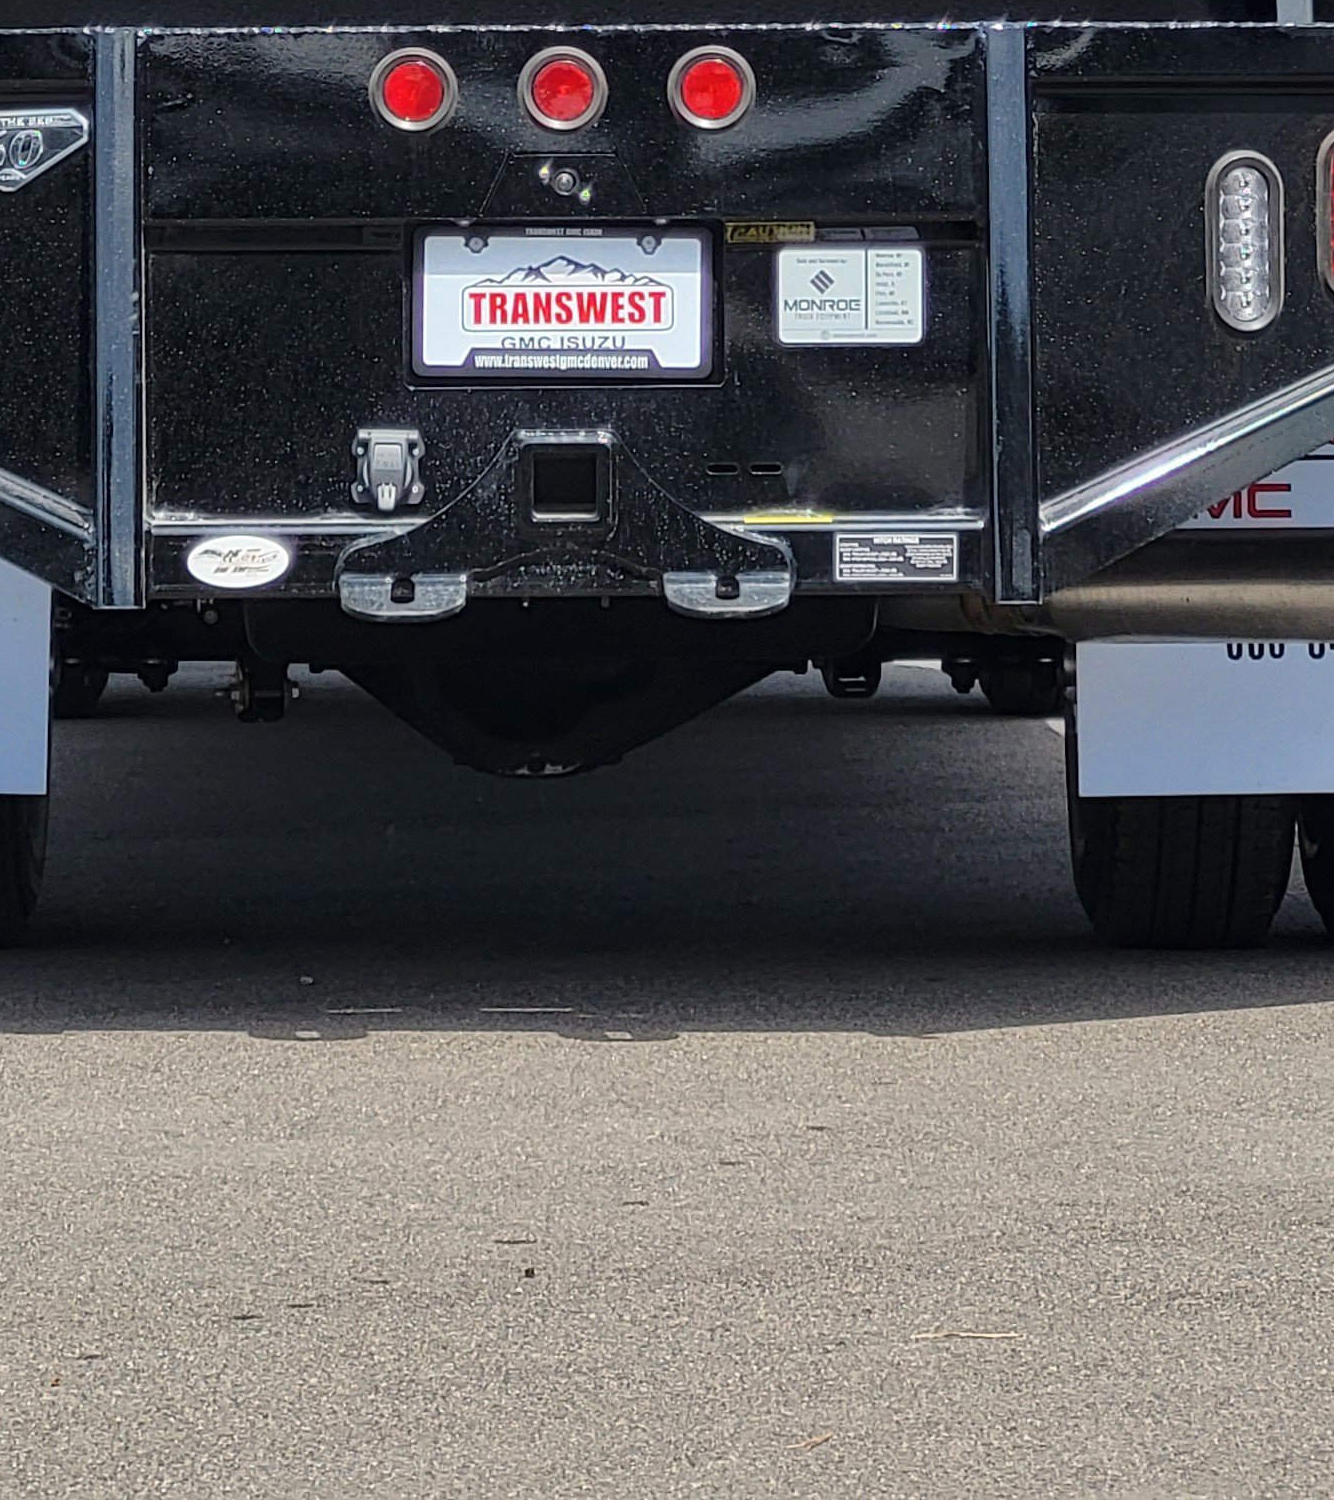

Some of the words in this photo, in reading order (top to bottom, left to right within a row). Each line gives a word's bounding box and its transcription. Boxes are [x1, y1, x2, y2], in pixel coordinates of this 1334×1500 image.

[1, 118, 25, 127] THE
[469, 291, 667, 325] TRANSWEST
[783, 299, 861, 312] MONROE
[501, 335, 552, 350] GMC
[560, 335, 627, 350] ISUZU
[474, 353, 649, 371] www.transwestgmcdenver.com
